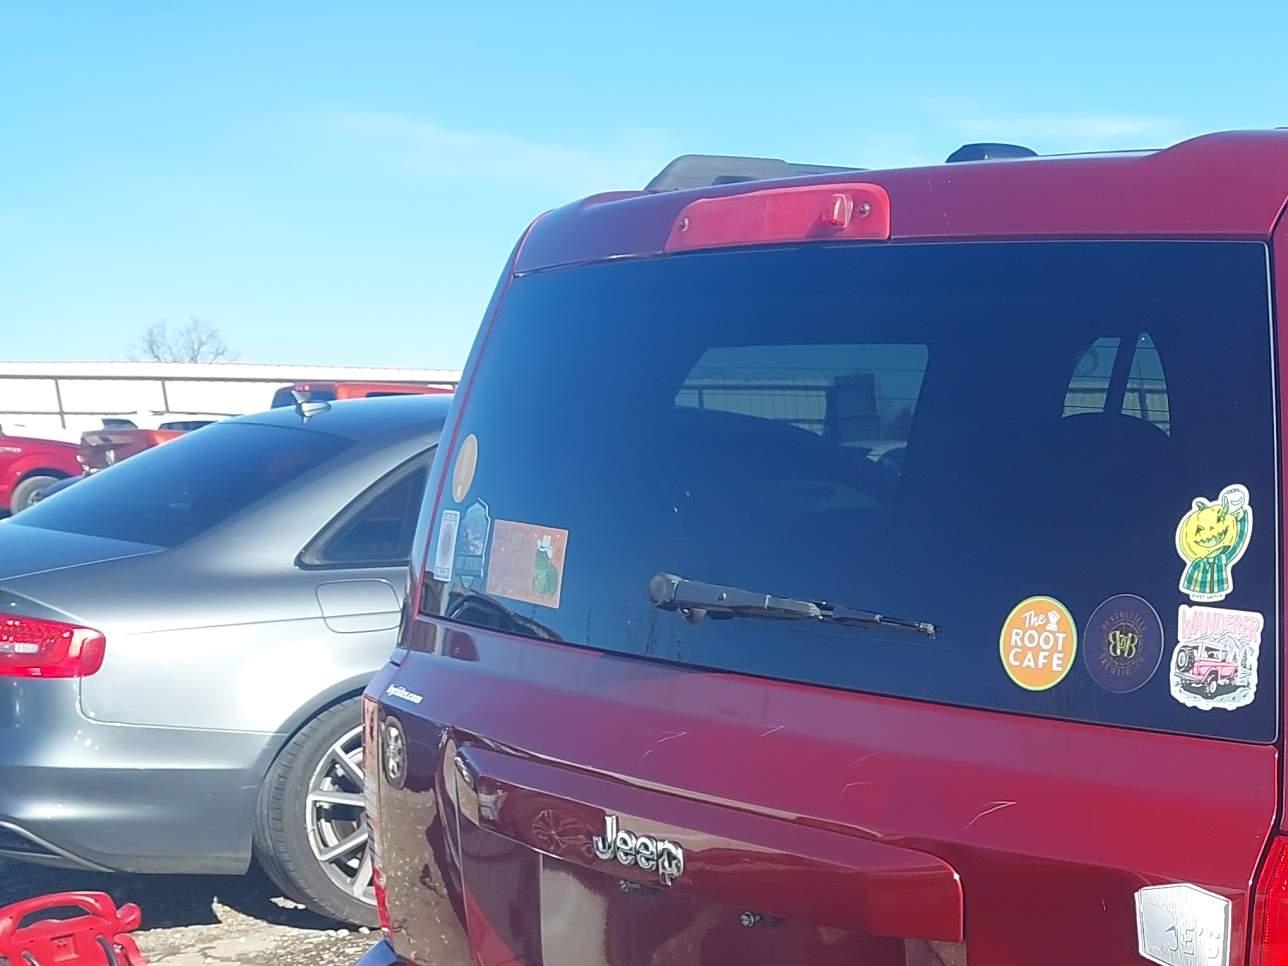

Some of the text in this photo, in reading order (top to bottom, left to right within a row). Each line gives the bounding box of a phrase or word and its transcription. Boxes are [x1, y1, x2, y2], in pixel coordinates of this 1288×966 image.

[1021, 609, 1047, 628] The
[1181, 608, 1260, 643] WANDERER
[1011, 628, 1067, 651] ROOT
[1008, 648, 1064, 672] CAFE
[592, 815, 684, 887] Jeep
